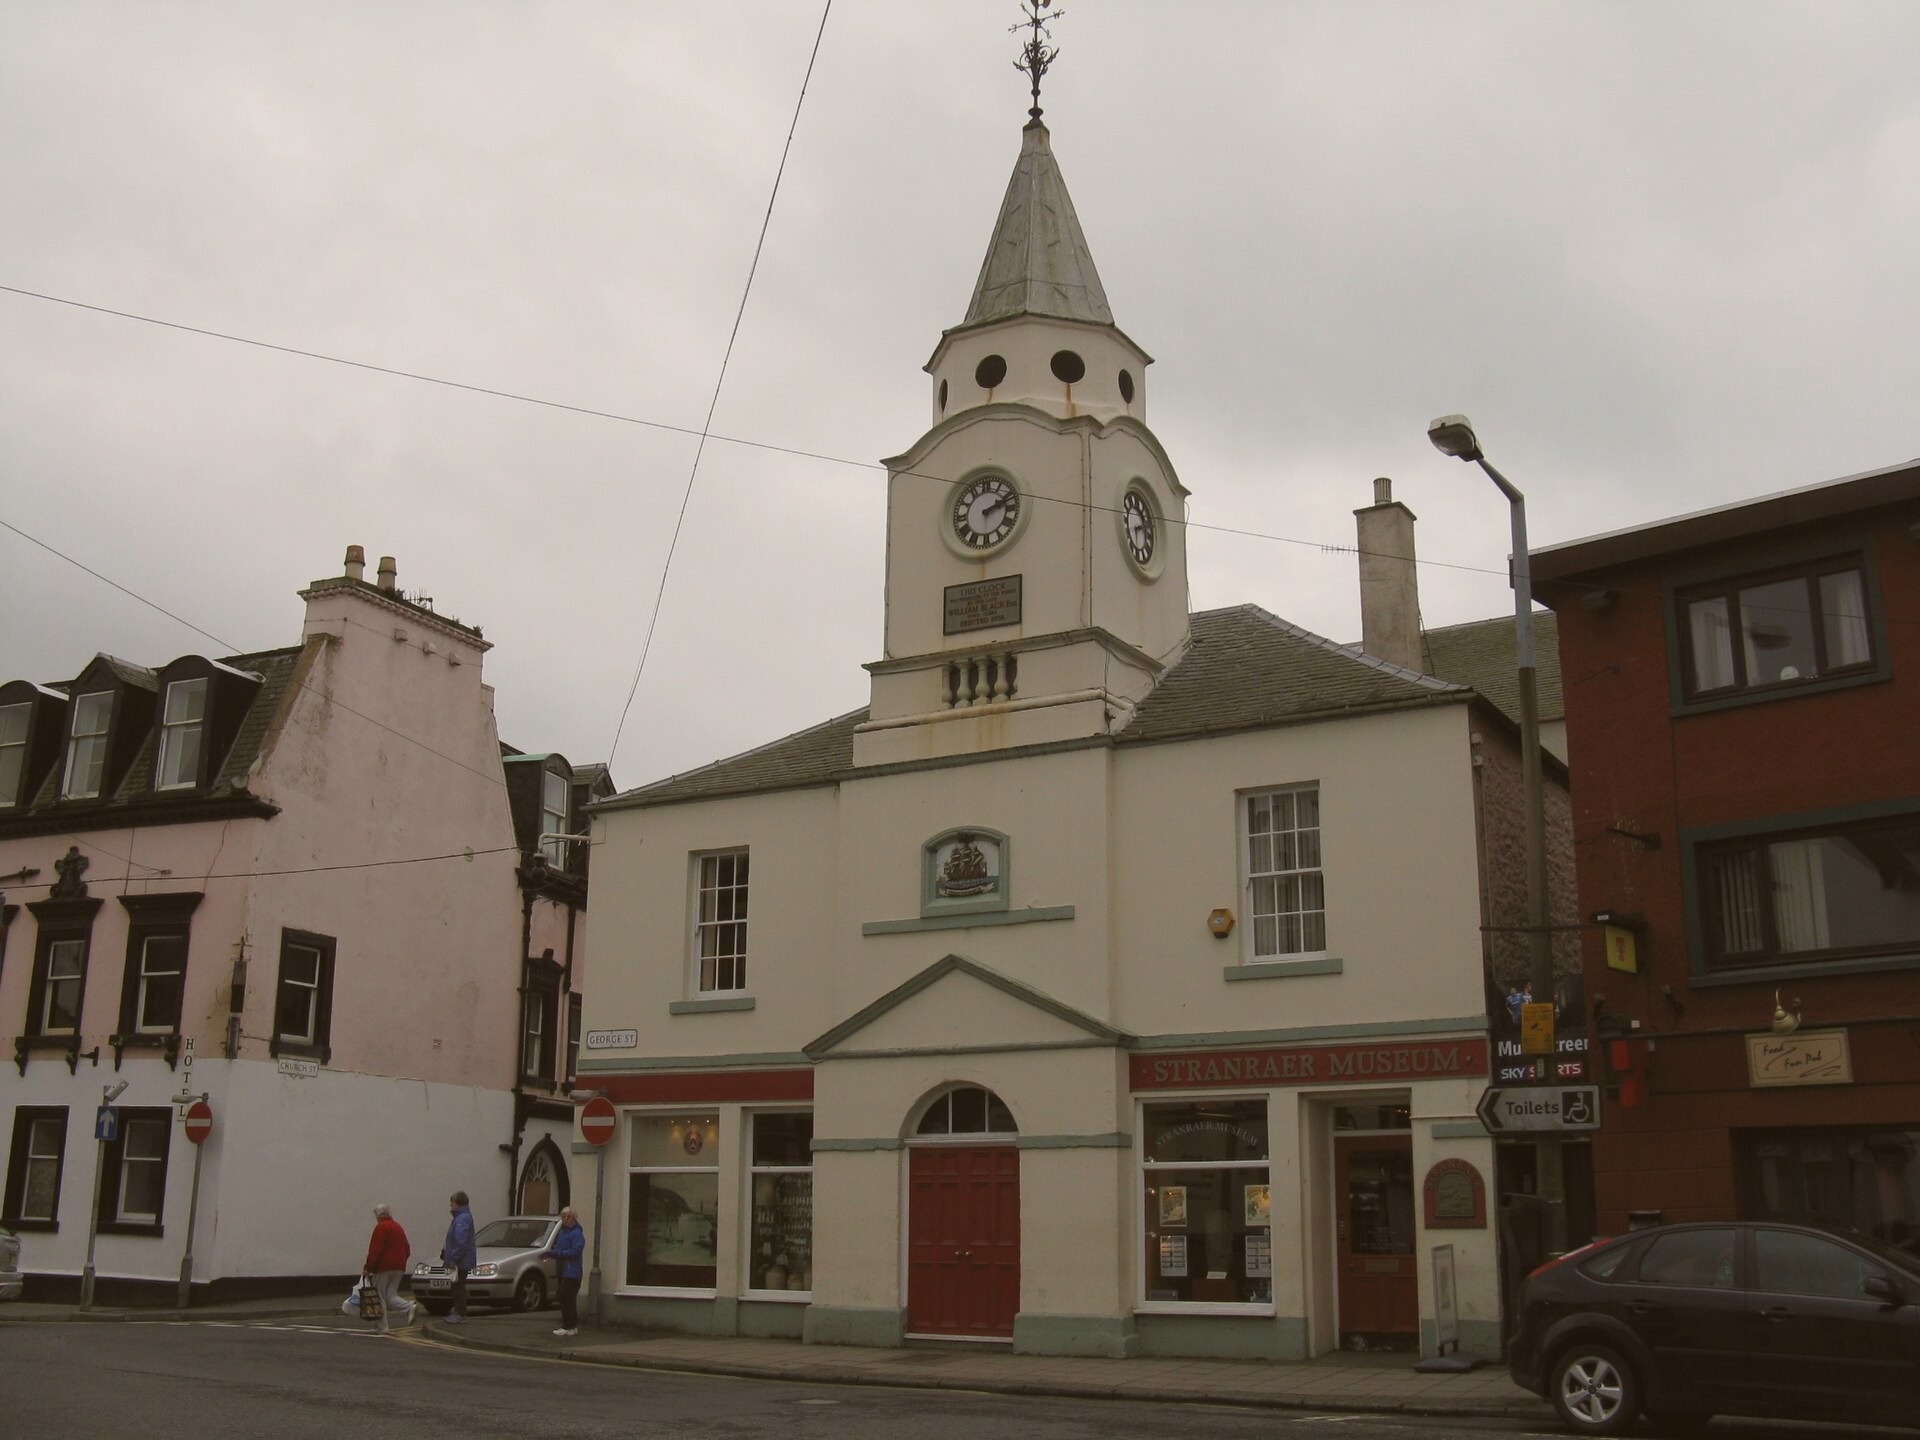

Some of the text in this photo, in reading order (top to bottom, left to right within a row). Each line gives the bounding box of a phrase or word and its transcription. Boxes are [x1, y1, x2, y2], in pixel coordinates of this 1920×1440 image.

[960, 587, 976, 596] THIS
[979, 582, 1006, 593] CLOCK
[589, 1034, 634, 1044] GEORGE ST
[280, 1062, 307, 1073] CHURCH
[1153, 1047, 1460, 1083] STRANRAER MUSEUM
[1501, 1067, 1526, 1080] SKY
[1505, 1101, 1559, 1115] Toilets
[1155, 1121, 1259, 1147] STRANRAER MUSEUM
